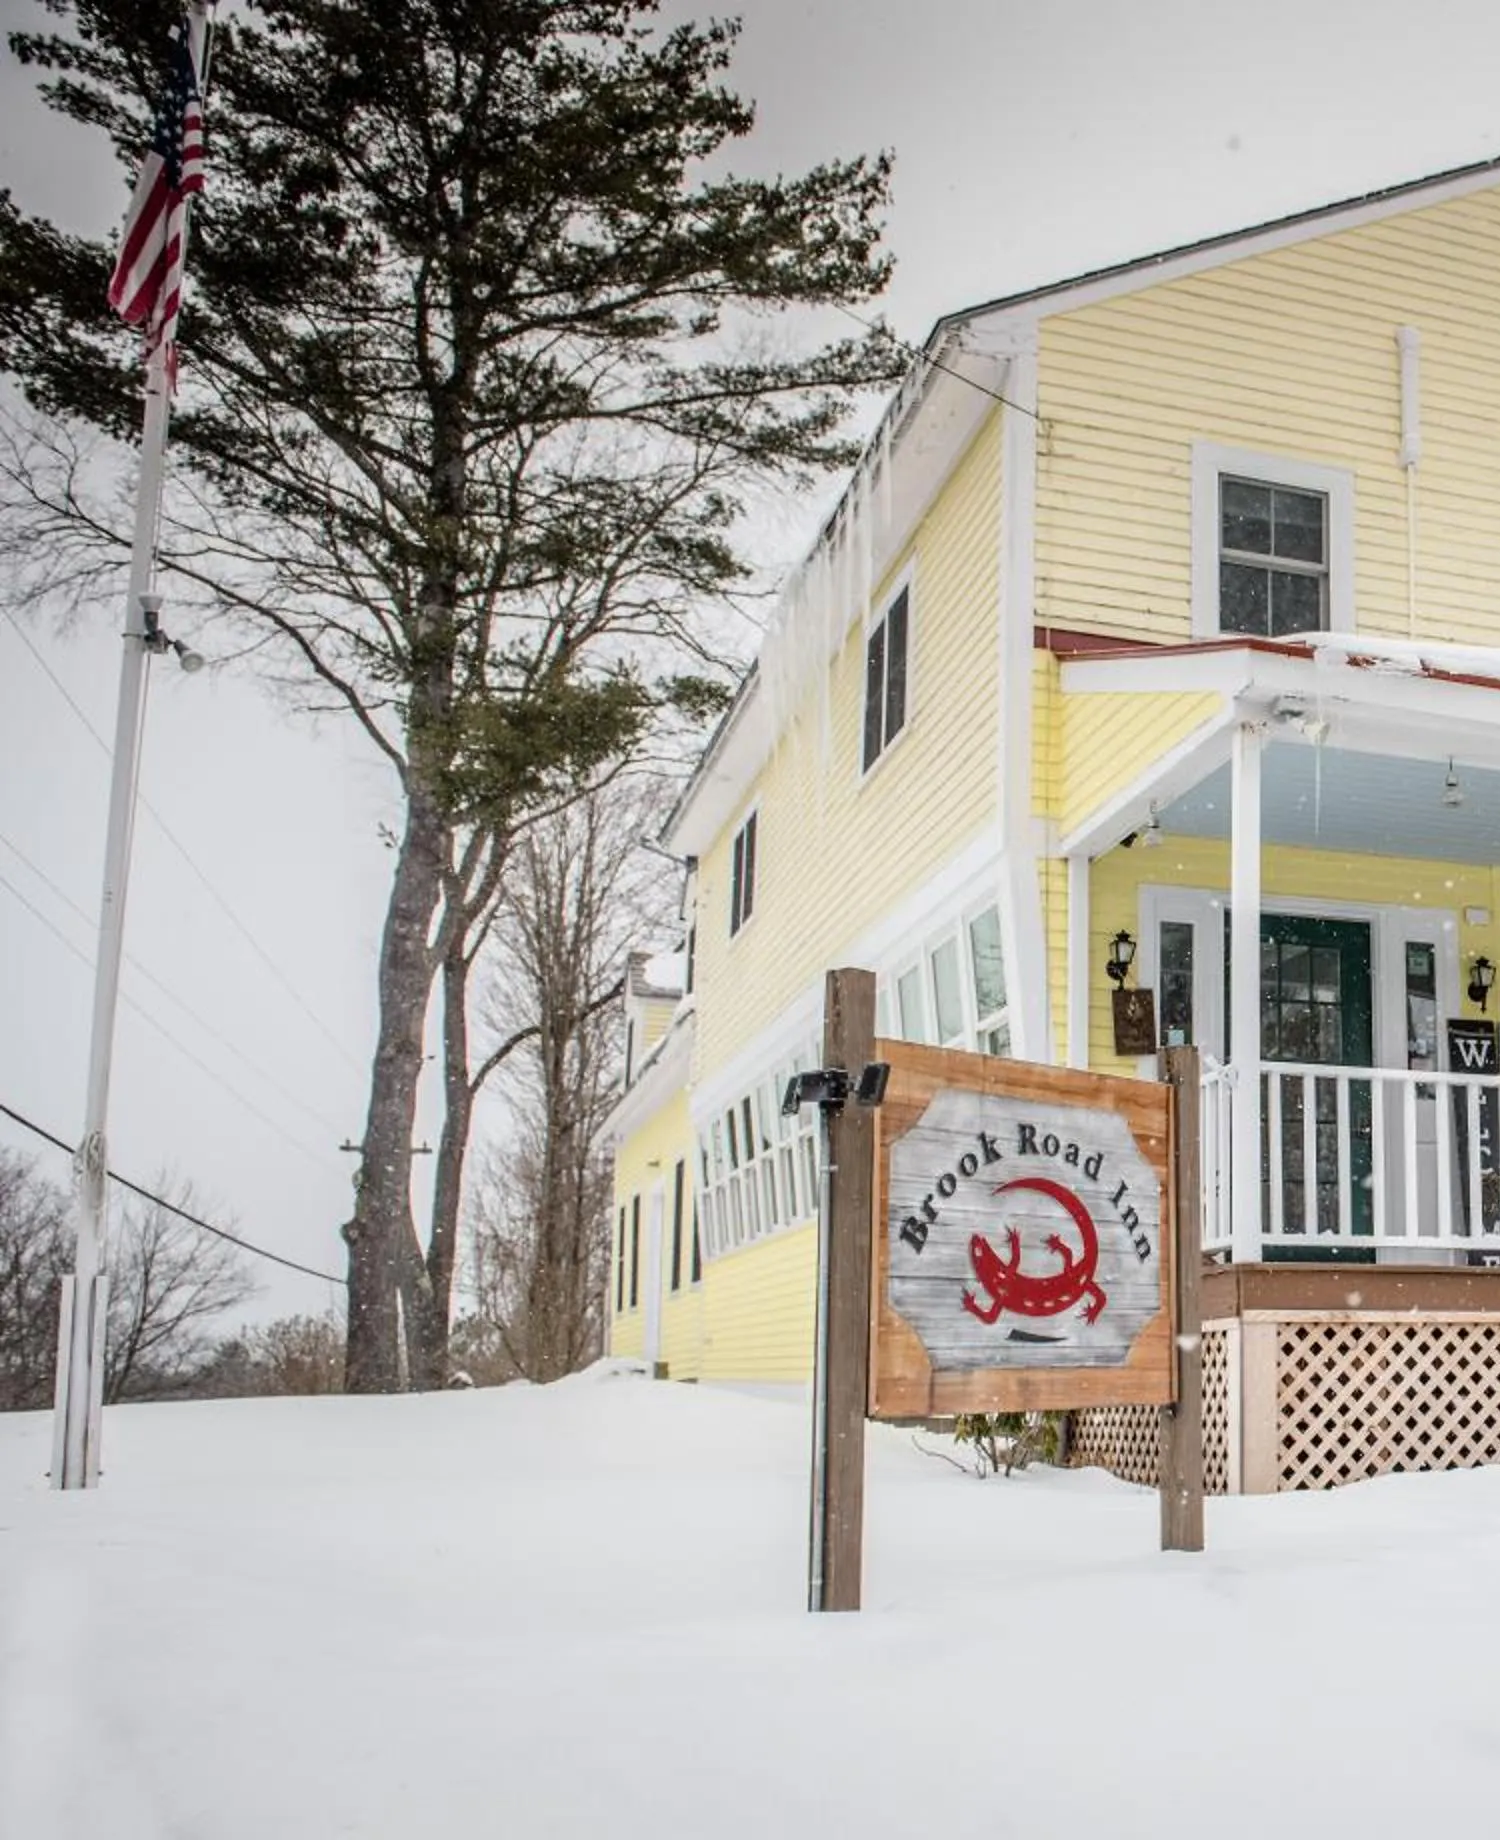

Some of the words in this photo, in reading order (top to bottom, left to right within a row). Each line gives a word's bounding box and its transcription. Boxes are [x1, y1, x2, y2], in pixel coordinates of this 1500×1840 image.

[899, 1131, 1003, 1255] Brook
[1017, 1123, 1104, 1181] Road
[1108, 1180, 1152, 1264] Inn
